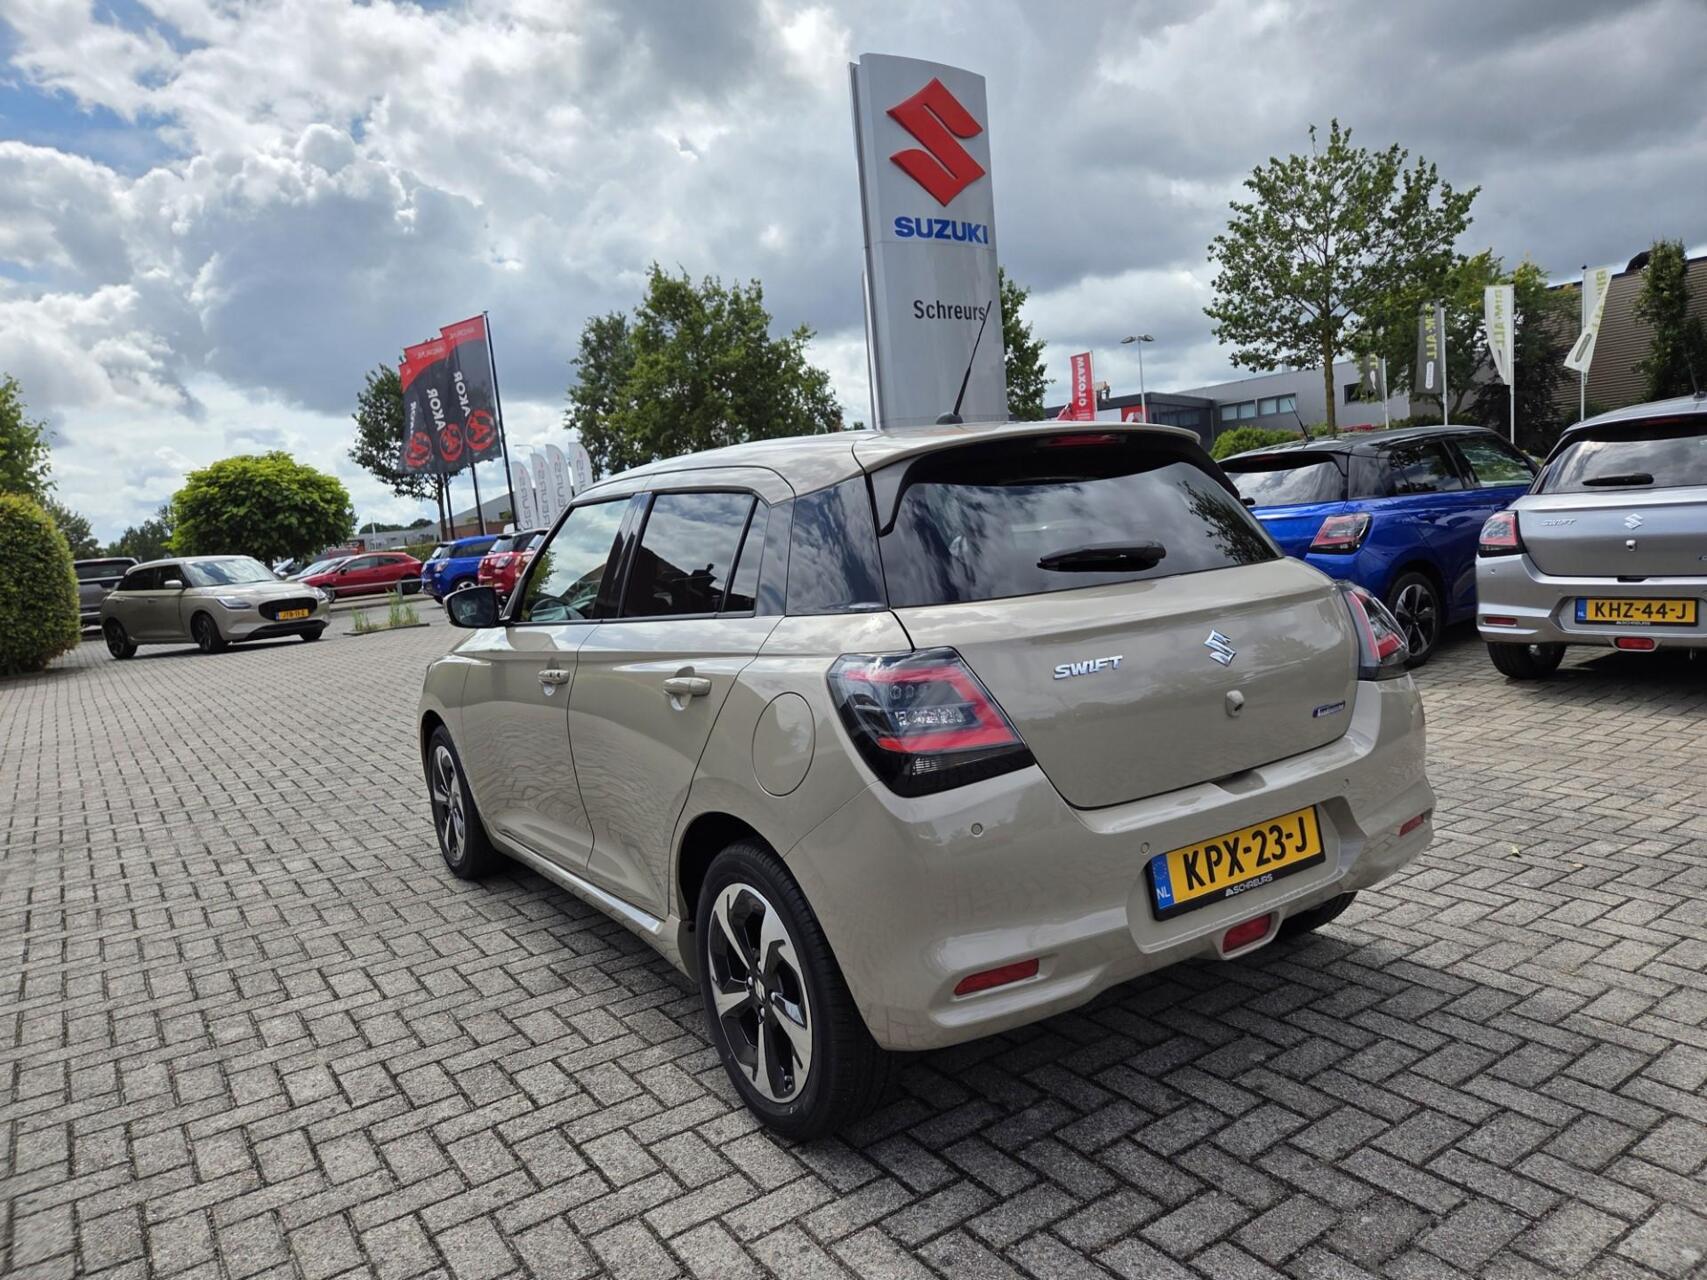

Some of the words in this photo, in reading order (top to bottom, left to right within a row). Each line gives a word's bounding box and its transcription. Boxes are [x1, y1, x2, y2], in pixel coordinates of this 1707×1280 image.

[894, 216, 989, 244] SUZUKI
[913, 299, 986, 321] Schreurs
[1594, 602, 1687, 619] KHZ-44-J
[1053, 655, 1123, 680] SWIFT
[1156, 887, 1171, 899] NL
[1182, 816, 1308, 891] KPX-23-J
